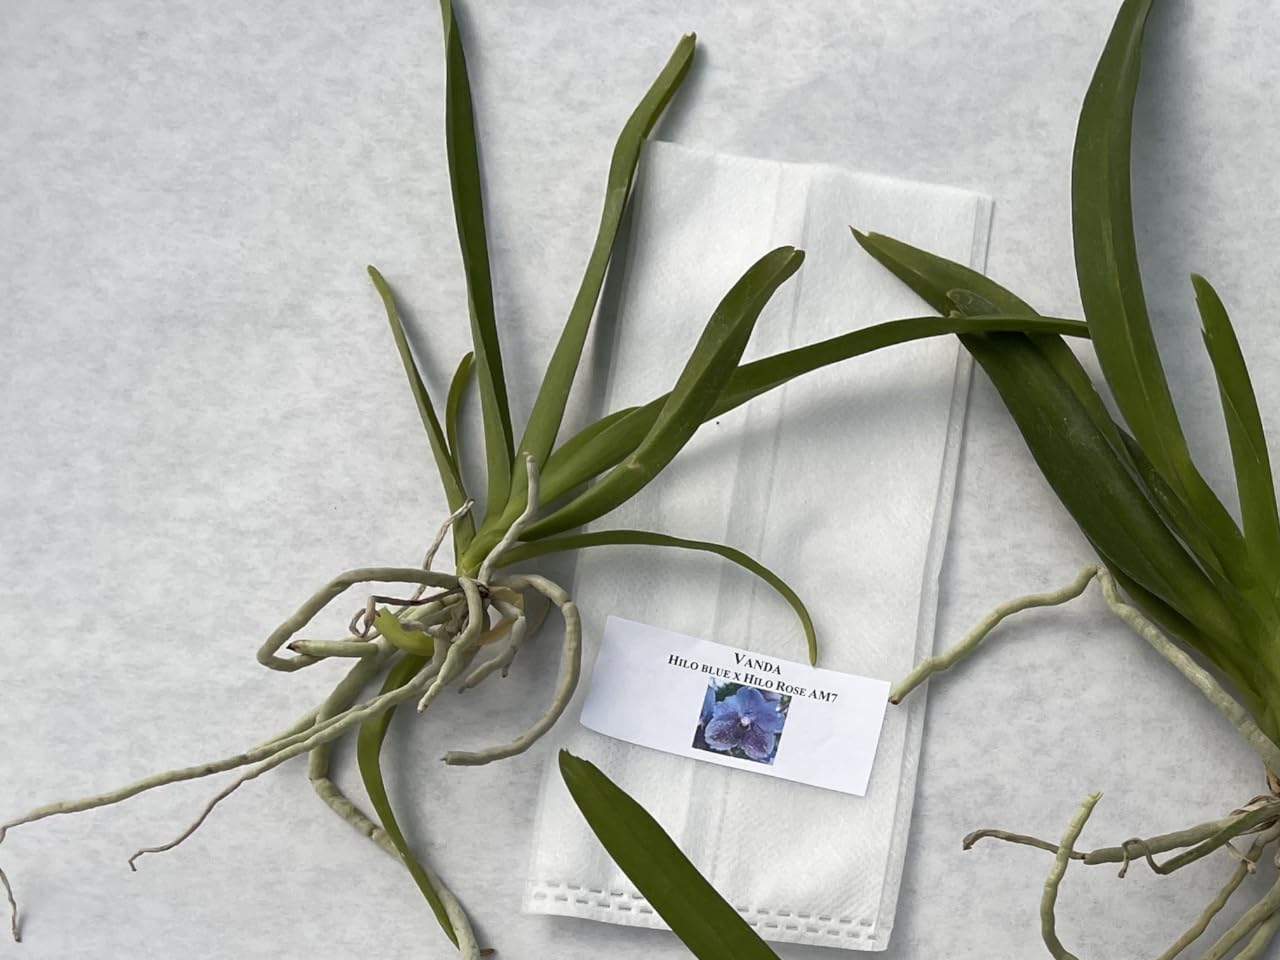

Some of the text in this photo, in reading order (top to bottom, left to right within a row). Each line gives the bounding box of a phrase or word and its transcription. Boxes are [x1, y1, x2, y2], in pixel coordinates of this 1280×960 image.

[668, 654, 699, 671] HILO
[701, 664, 731, 679] BLUE
[743, 674, 774, 689] HILO
[776, 681, 807, 697] ROSE
[808, 690, 839, 703] AM7
[734, 652, 782, 675] VANDA
